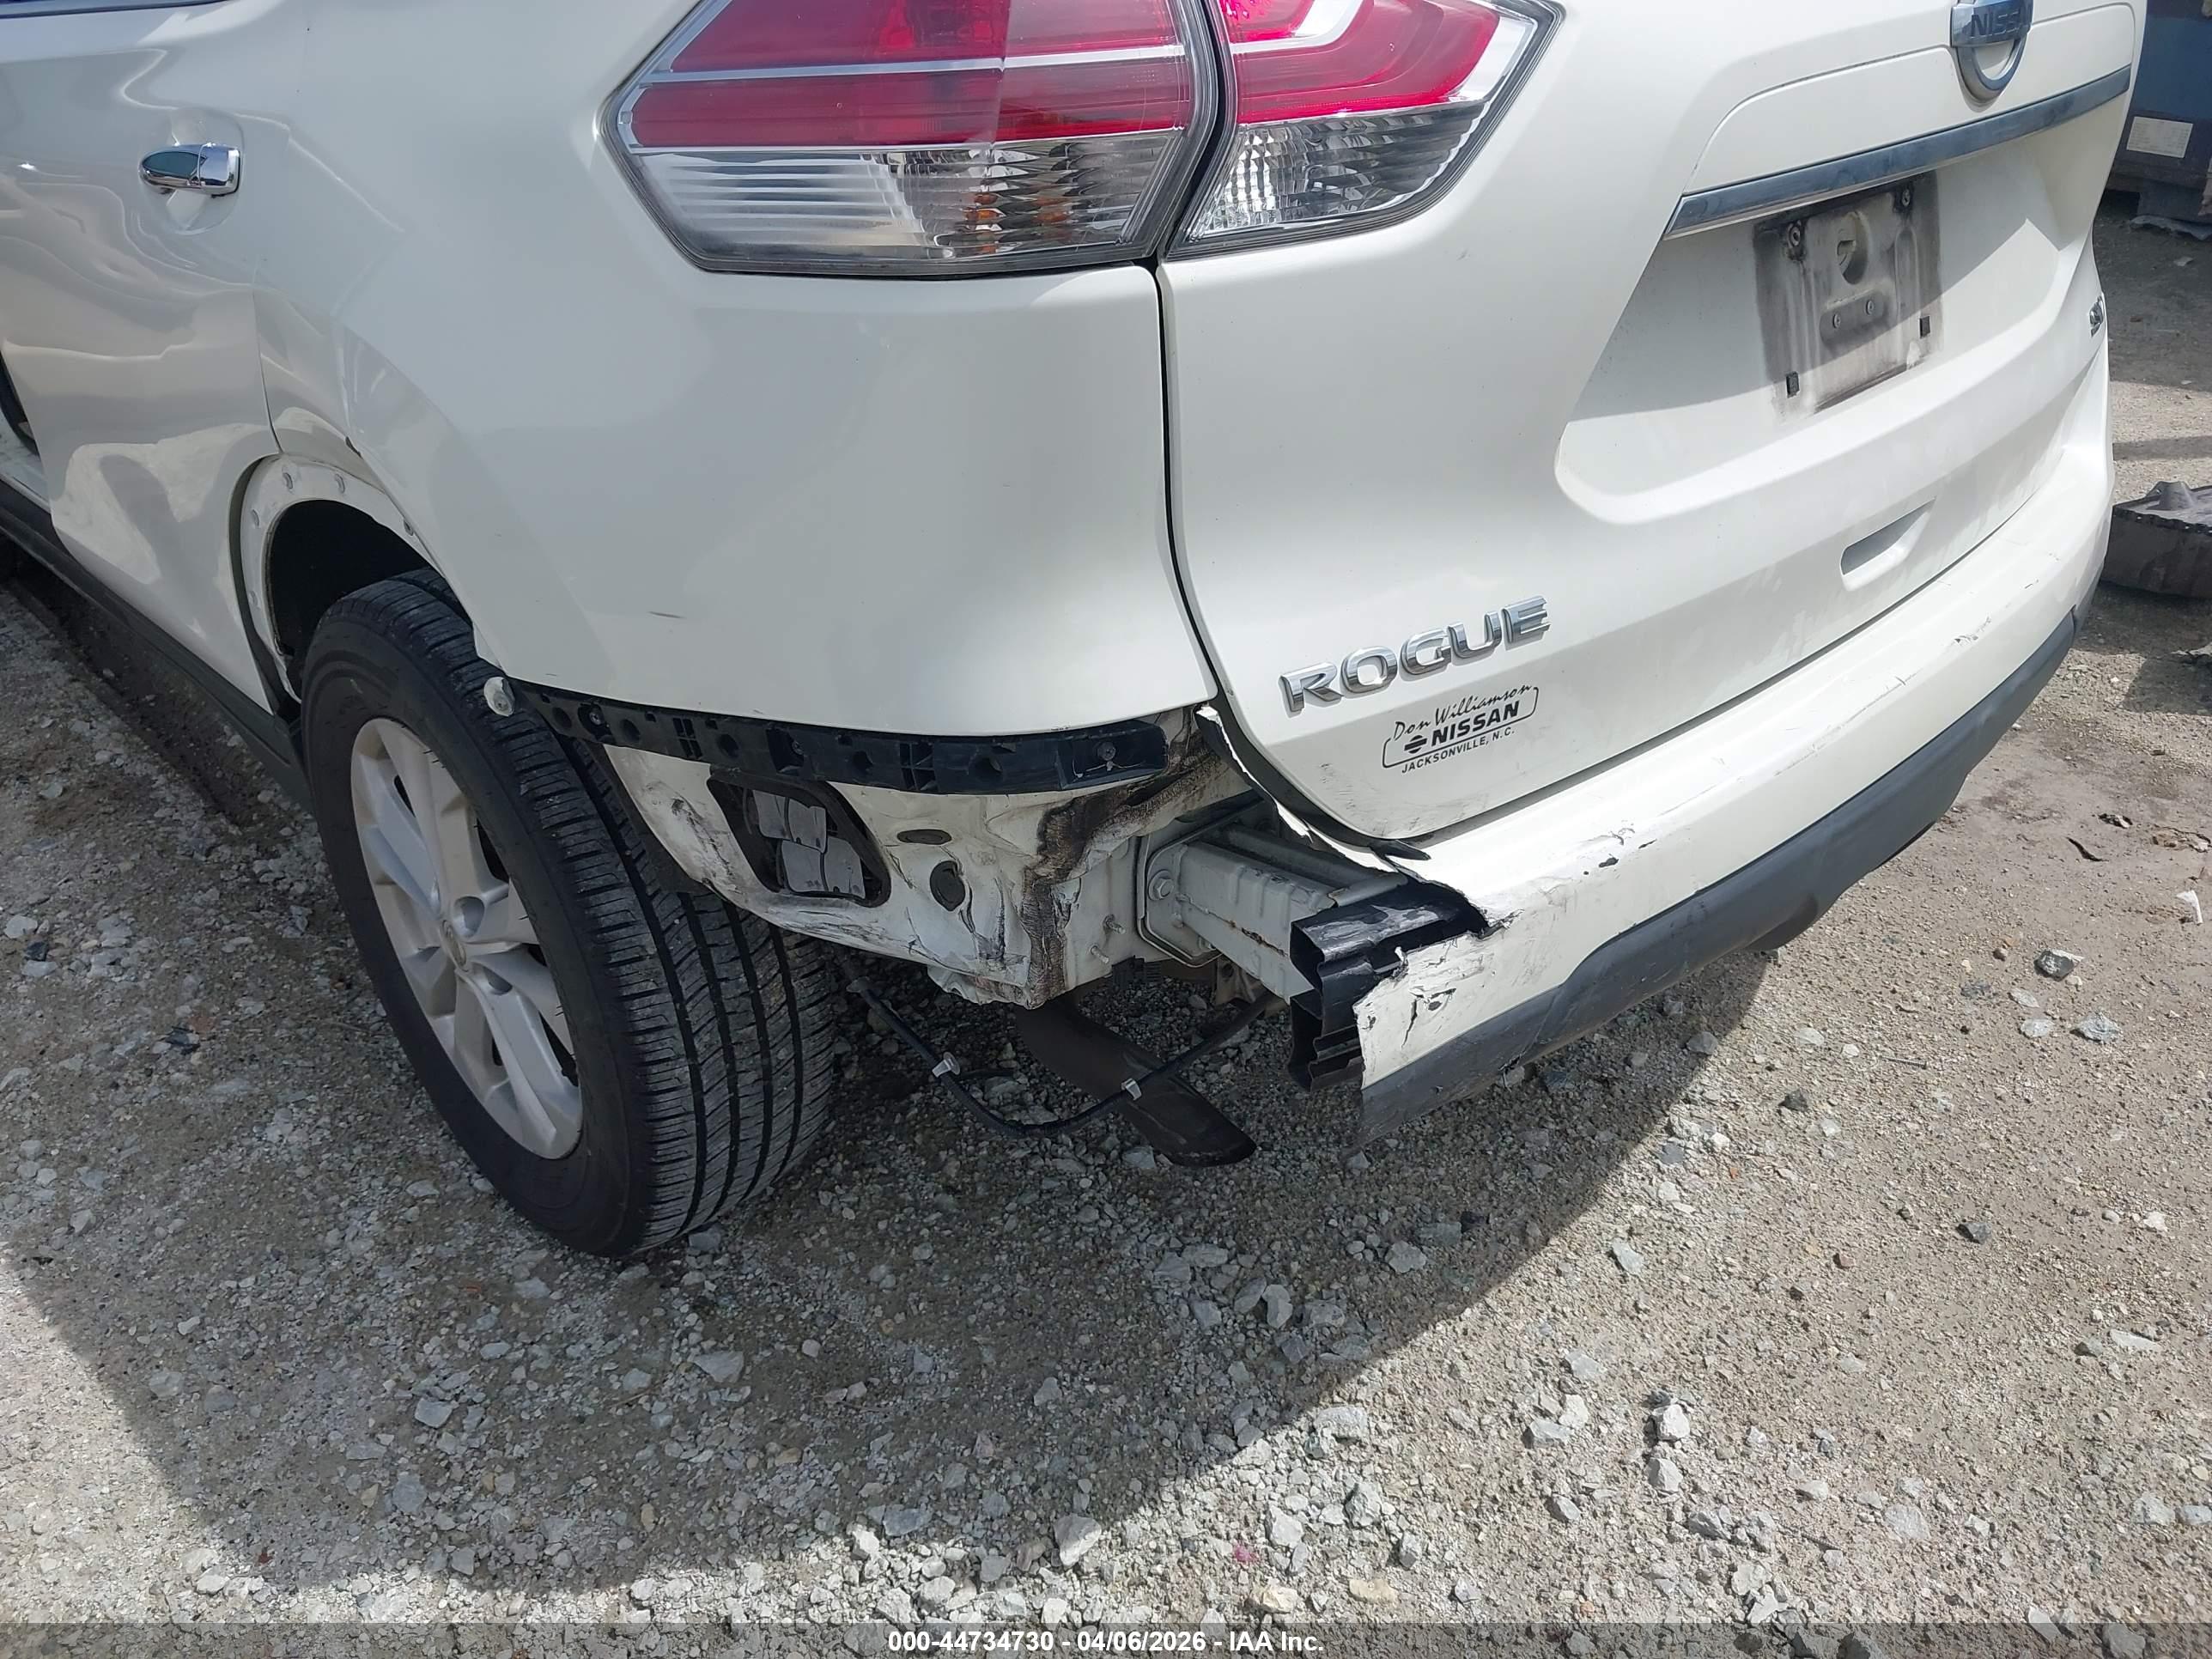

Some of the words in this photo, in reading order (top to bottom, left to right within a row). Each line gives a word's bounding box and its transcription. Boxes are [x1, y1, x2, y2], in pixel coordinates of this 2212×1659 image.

[1969, 5, 2028, 39] NISS
[1279, 595, 1551, 714] ROGUE
[1393, 720, 1431, 741] Don
[1435, 684, 1532, 726] Williamson
[1431, 700, 1520, 747] NISSAN
[1401, 736, 1490, 774] JACKSONVILLE,
